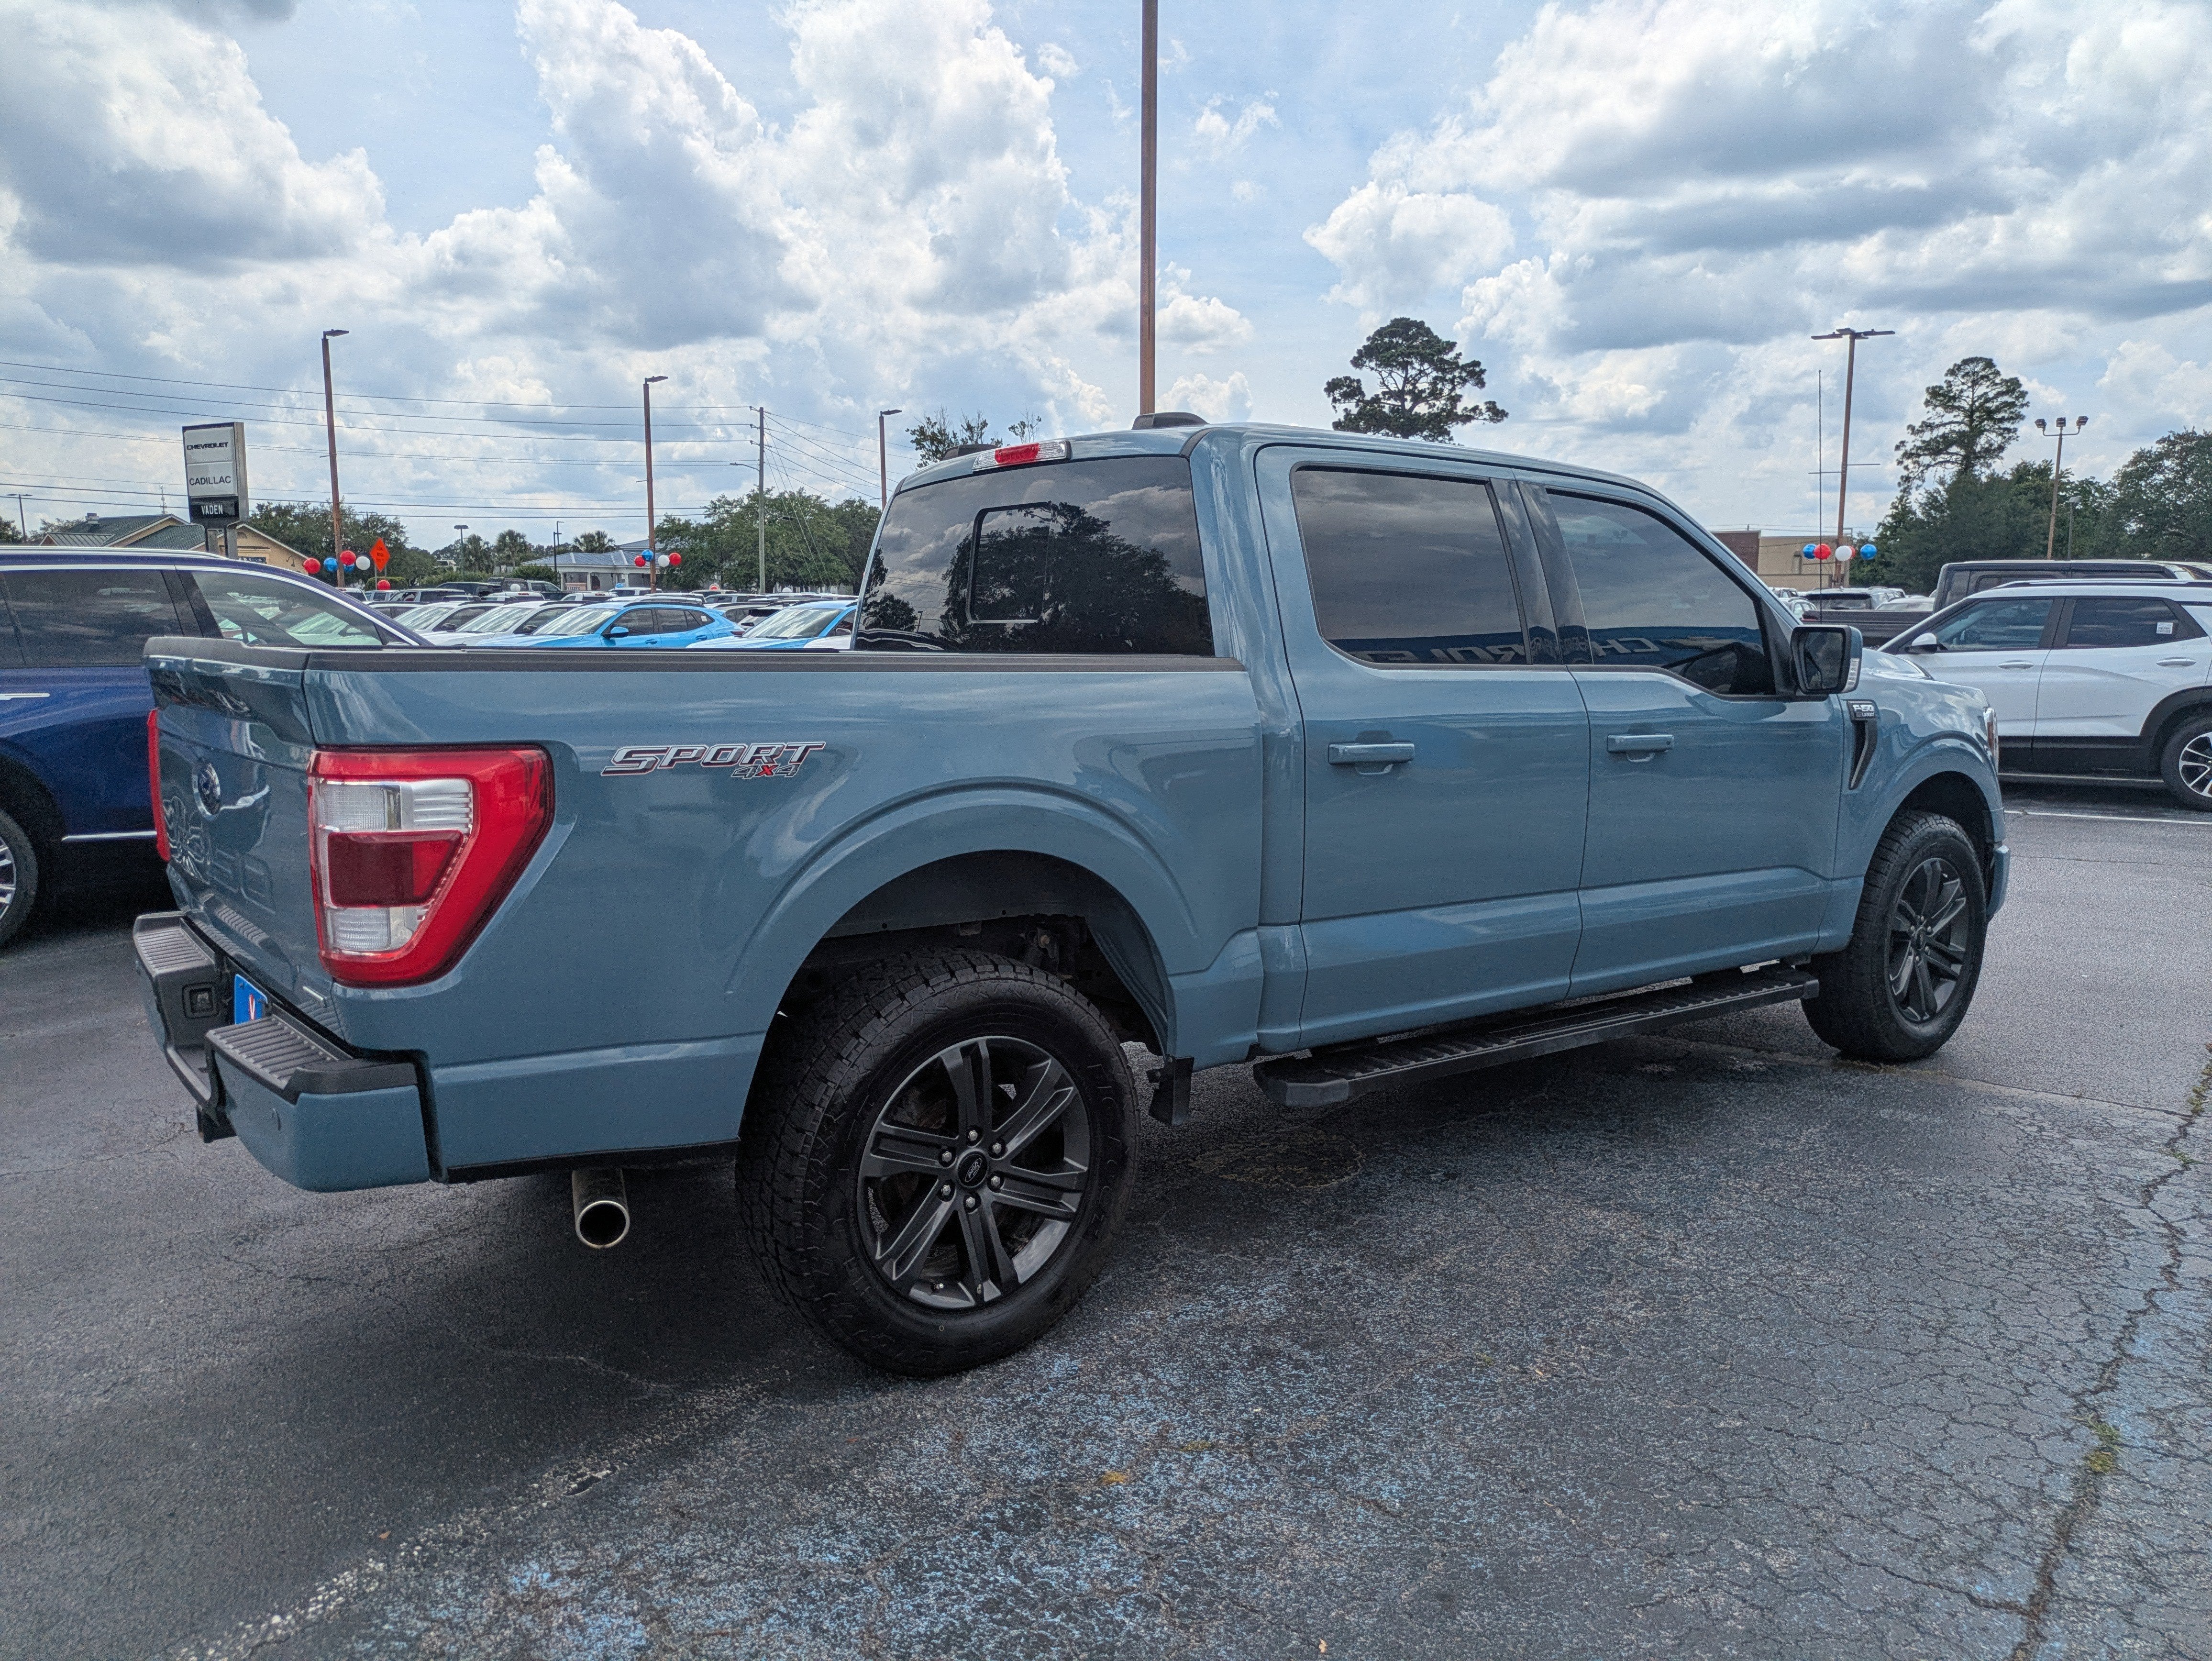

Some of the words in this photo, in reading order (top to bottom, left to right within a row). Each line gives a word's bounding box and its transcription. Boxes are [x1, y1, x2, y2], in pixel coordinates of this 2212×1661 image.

[187, 442, 228, 450] CHEVROLET
[189, 476, 231, 486] CADILLAC
[201, 504, 223, 515] VADEN
[601, 742, 826, 776] SPORT
